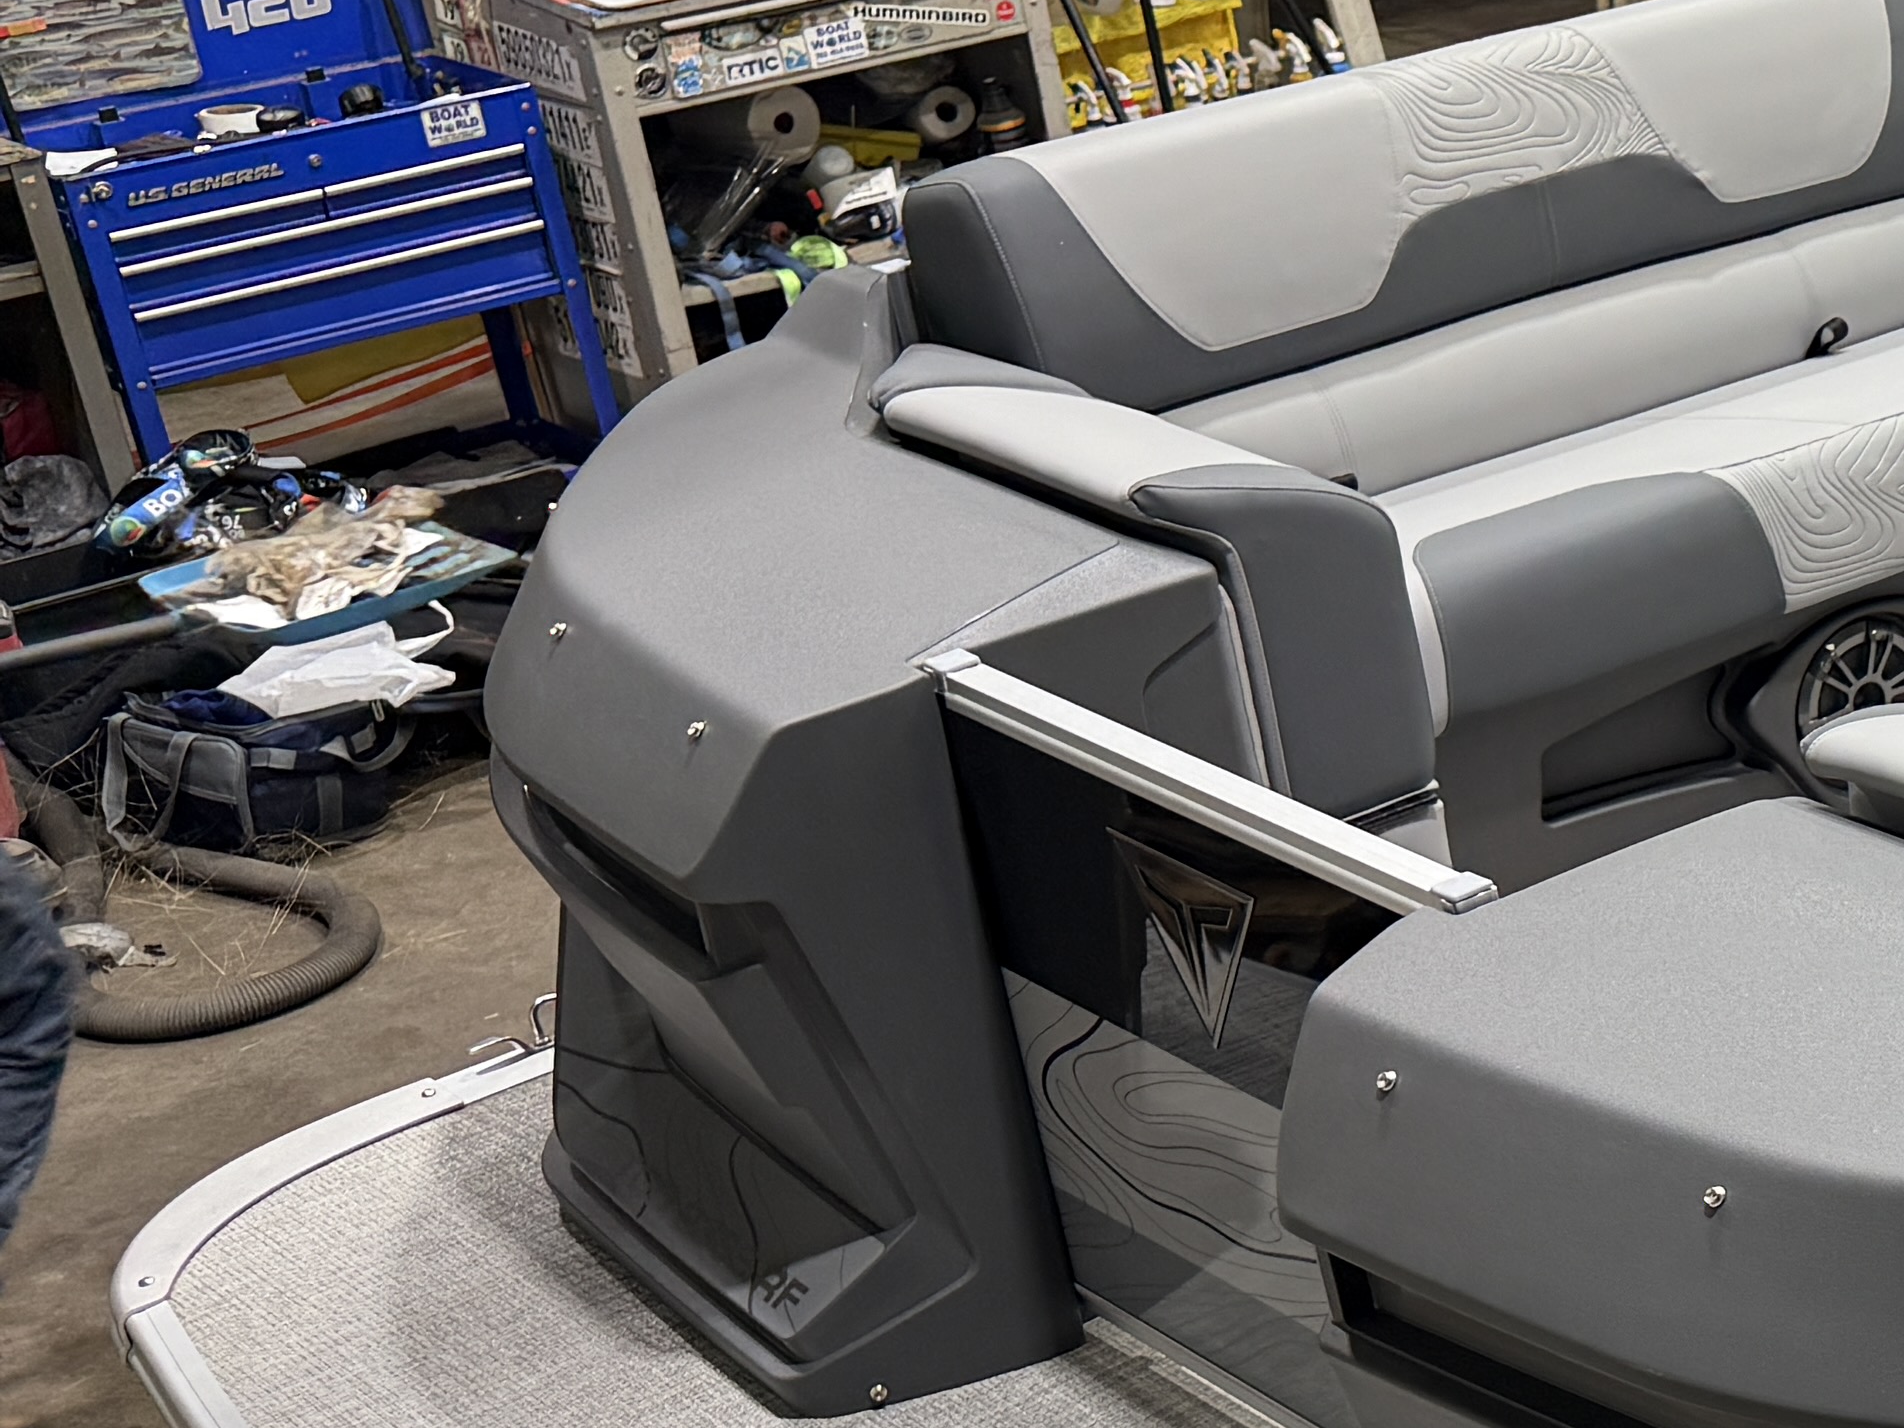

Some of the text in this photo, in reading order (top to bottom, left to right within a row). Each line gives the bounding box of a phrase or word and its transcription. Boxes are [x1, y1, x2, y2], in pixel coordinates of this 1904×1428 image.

[852, 4, 987, 24] HUMMINBIRD
[726, 55, 780, 81] RTIC
[429, 104, 472, 123] BOAT
[171, 161, 285, 198] GENERAL
